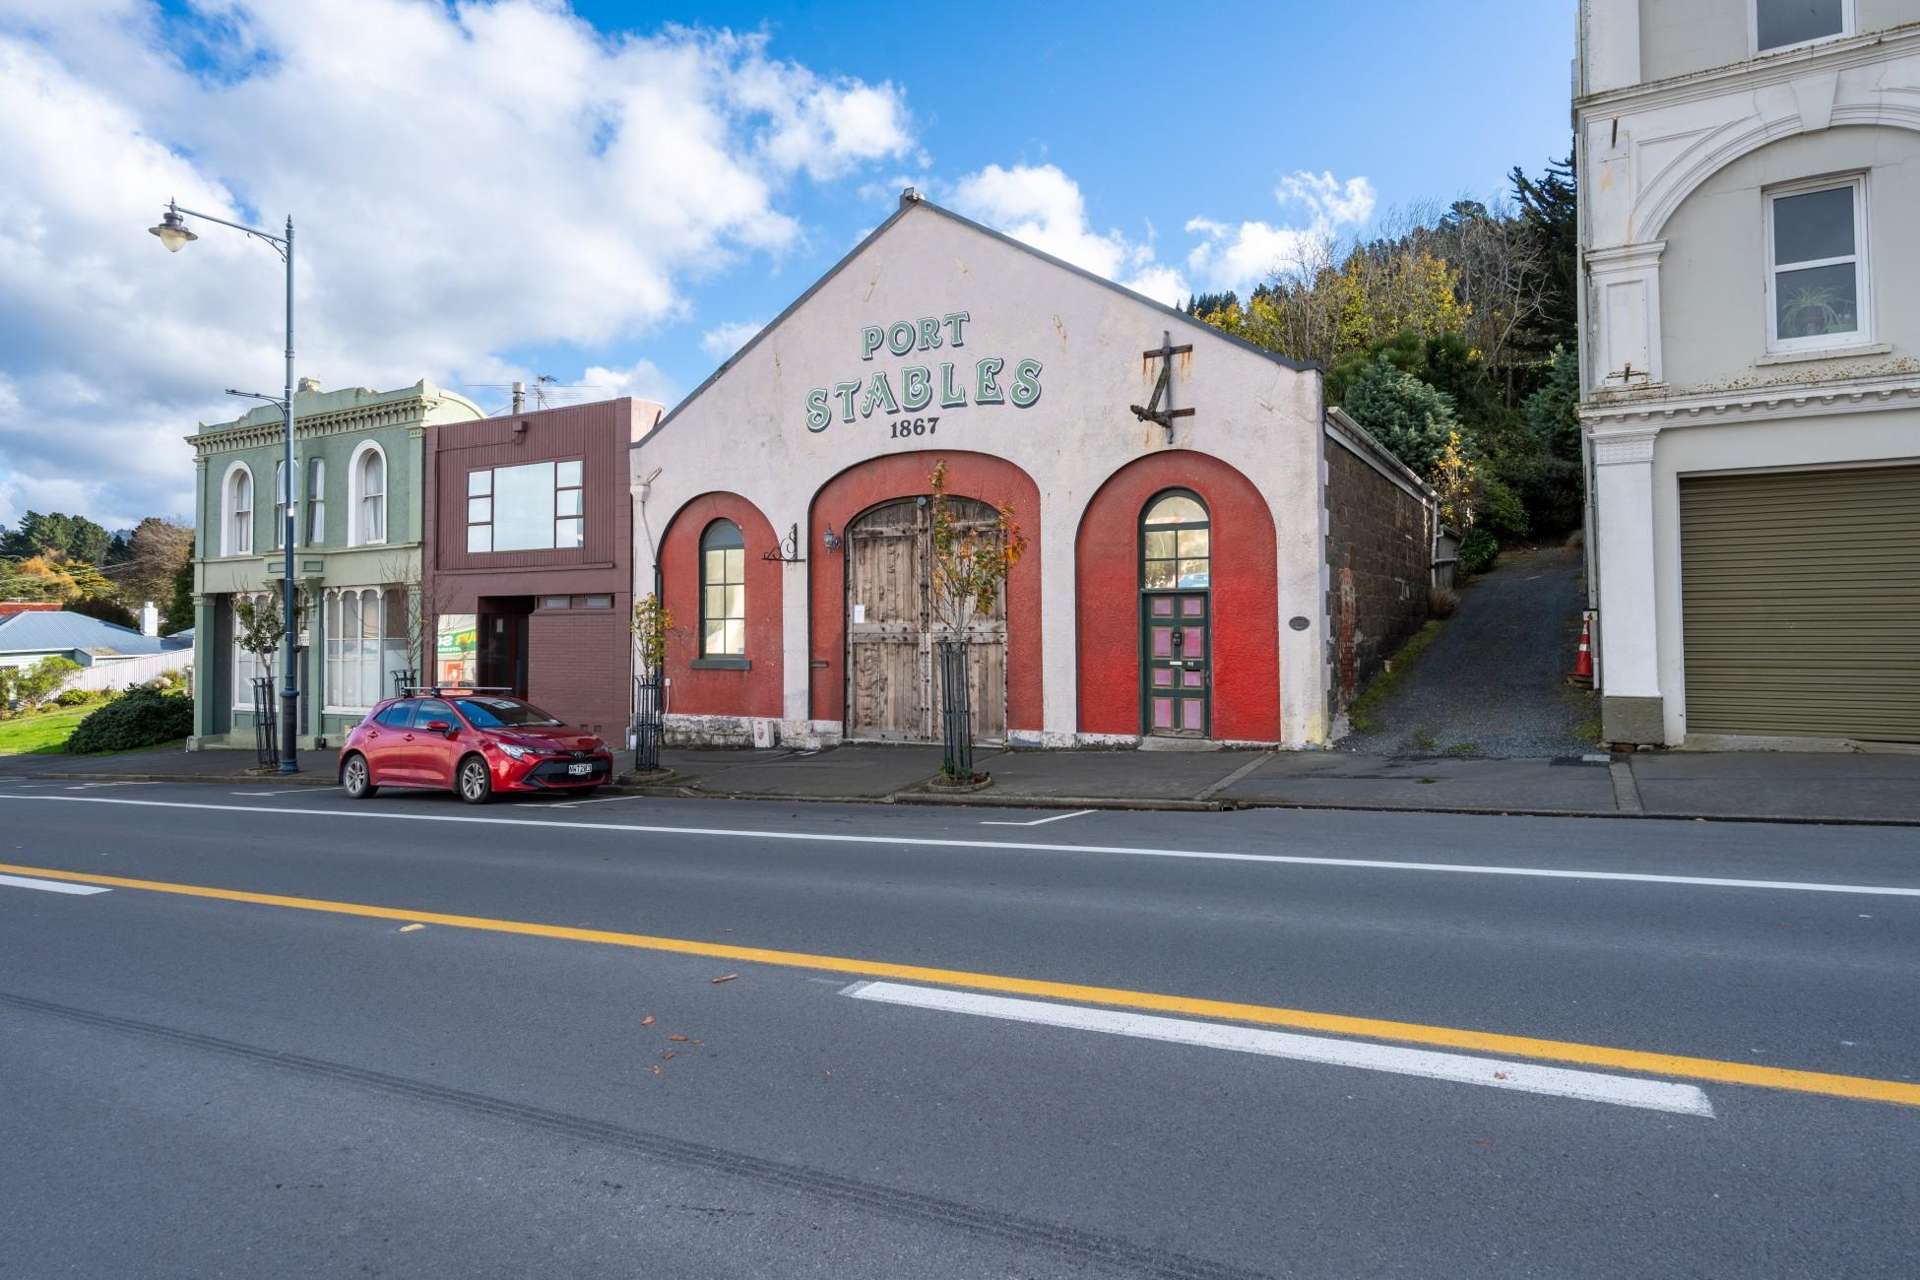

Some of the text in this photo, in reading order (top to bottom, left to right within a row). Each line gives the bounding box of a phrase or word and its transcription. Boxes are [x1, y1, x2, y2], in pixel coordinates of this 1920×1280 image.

[861, 311, 970, 360] PORT
[805, 358, 1042, 432] STABLES
[890, 417, 940, 438] 1867
